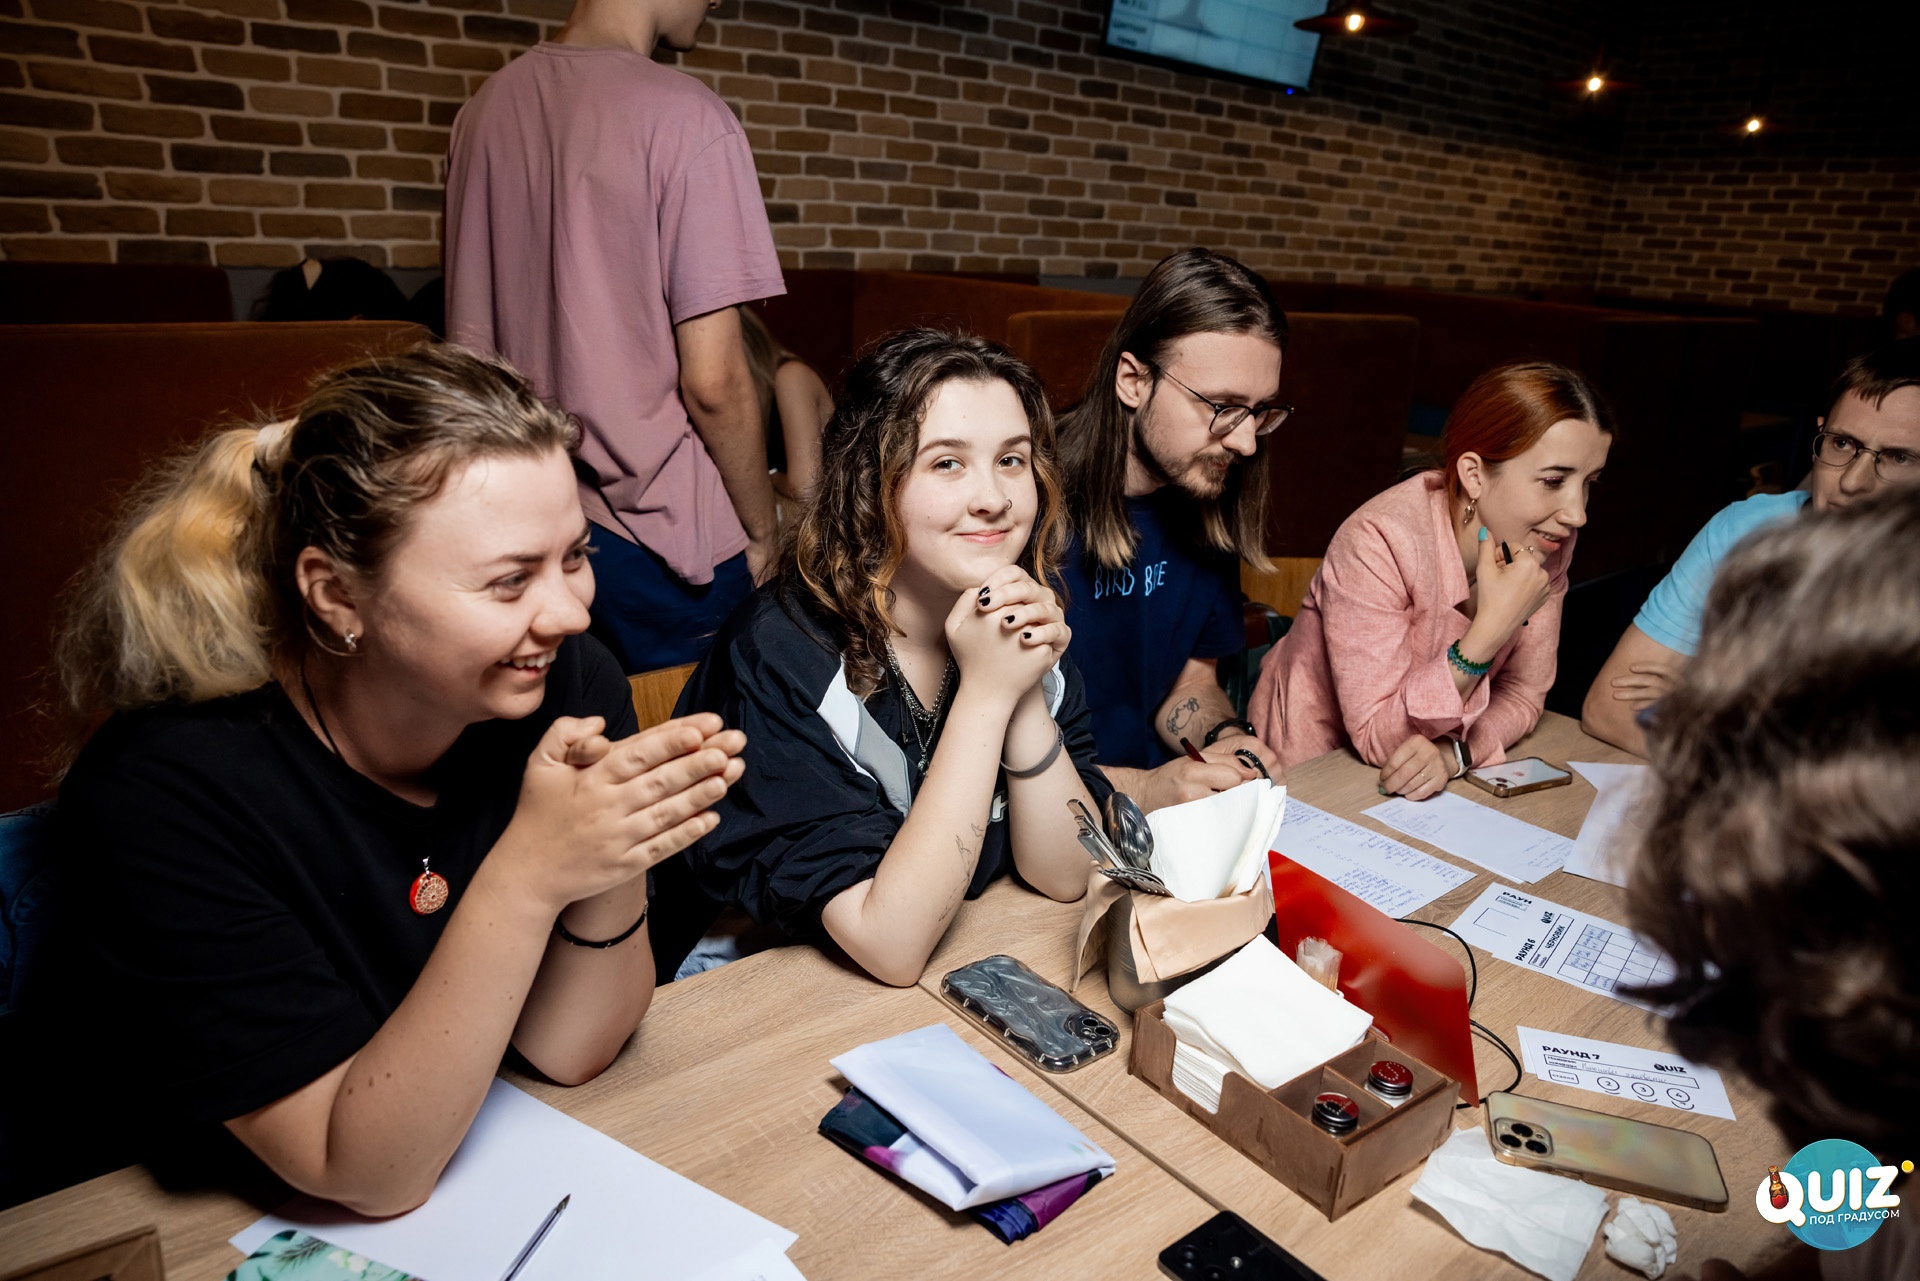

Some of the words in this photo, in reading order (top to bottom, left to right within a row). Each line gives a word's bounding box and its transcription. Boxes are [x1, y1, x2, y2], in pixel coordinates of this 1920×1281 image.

[1094, 565, 1135, 599] BIRD
[1545, 925, 1565, 949] ЧЕРНОВИК
[1515, 941, 1534, 961] РАУНД
[1542, 1045, 1591, 1060] РАУНД
[1653, 1063, 1687, 1074] QUIZ
